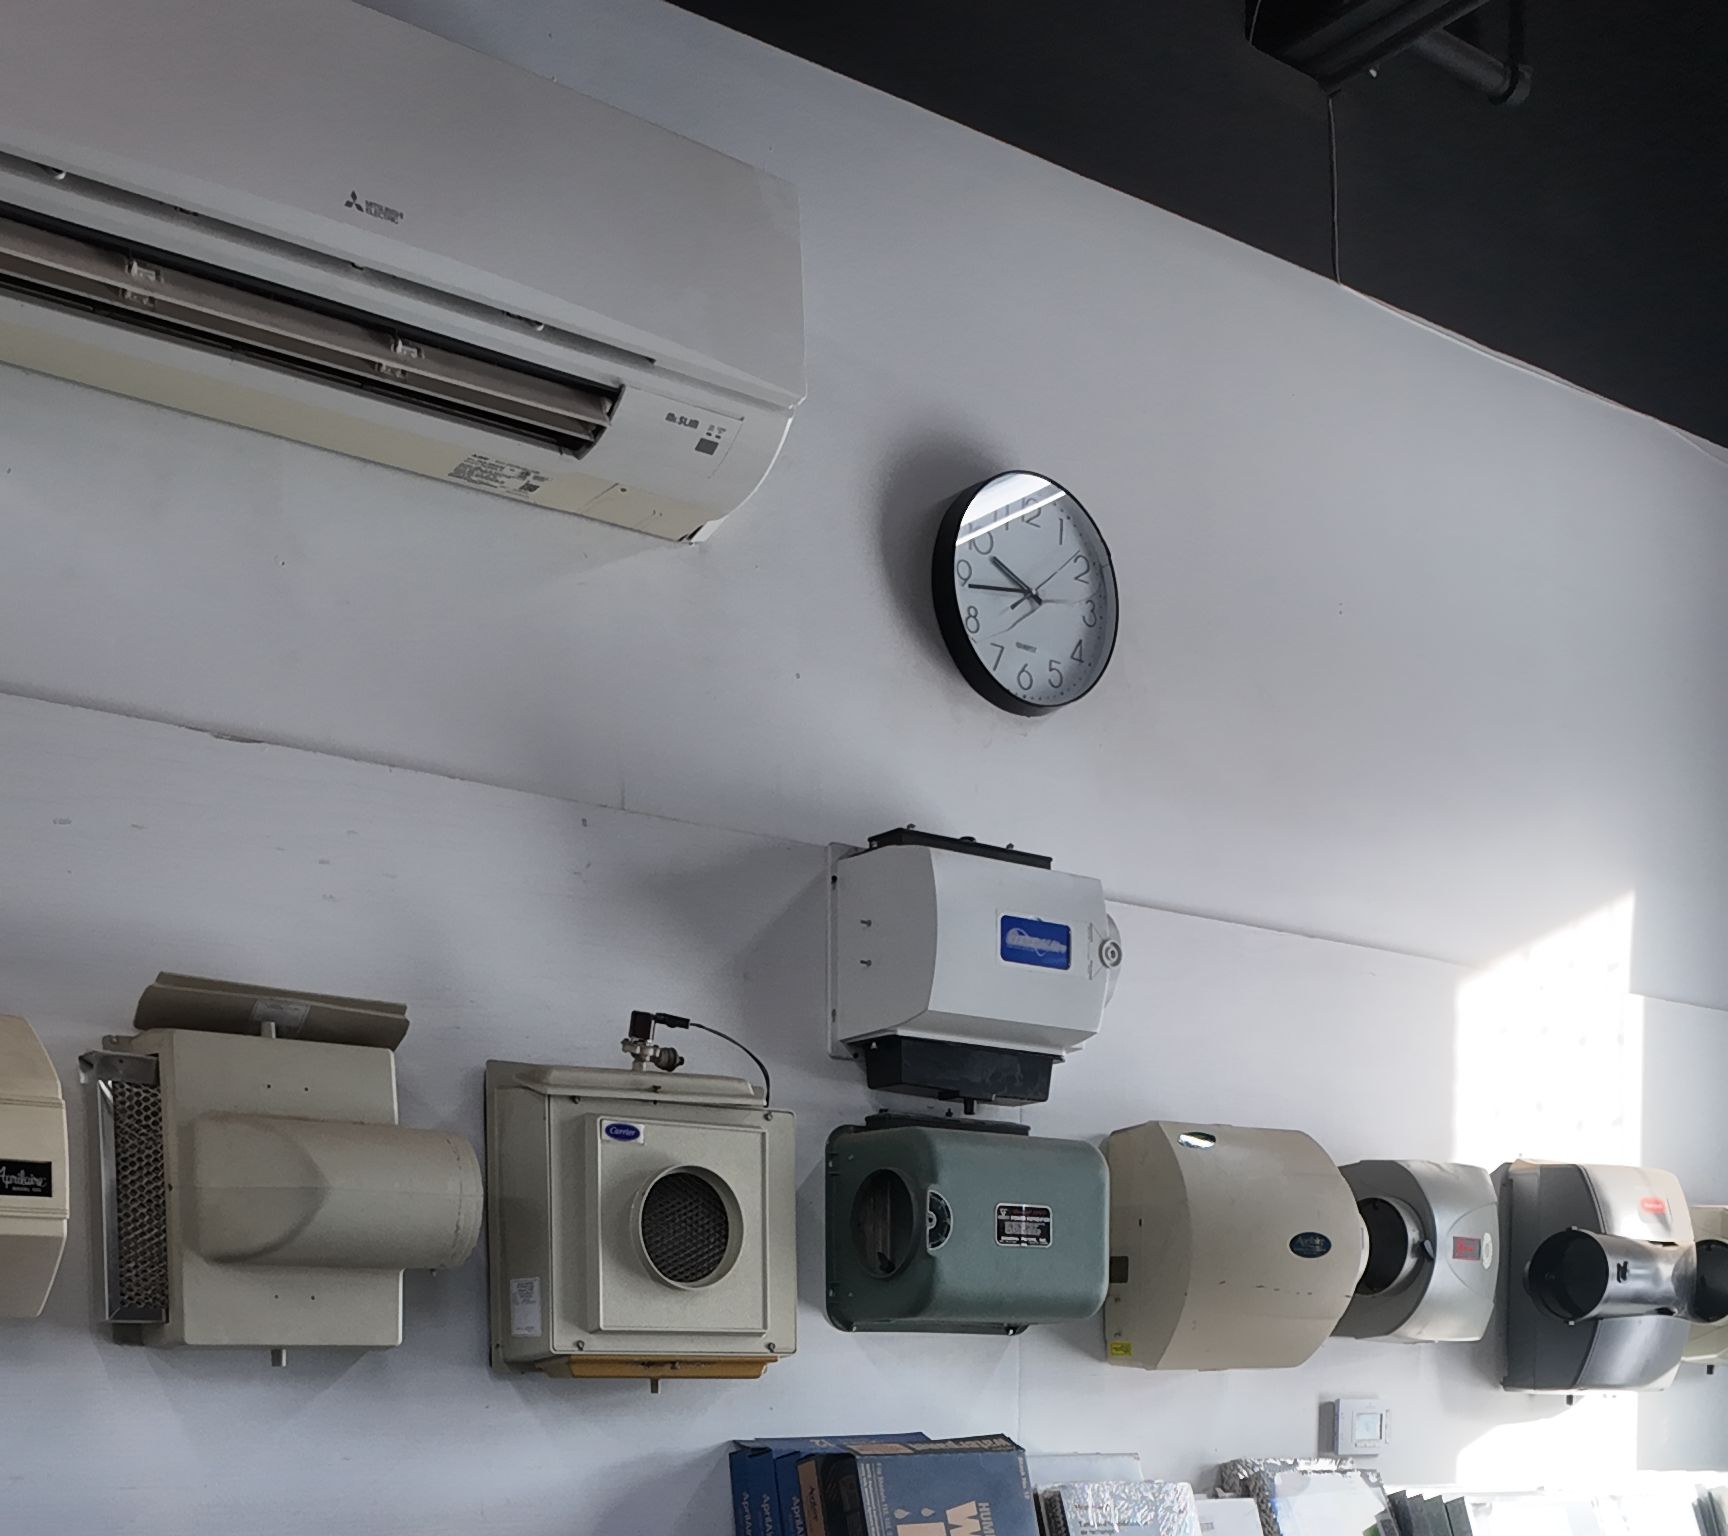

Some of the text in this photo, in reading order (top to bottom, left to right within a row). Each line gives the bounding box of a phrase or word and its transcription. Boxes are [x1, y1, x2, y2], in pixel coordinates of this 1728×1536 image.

[1059, 518, 1064, 546] 1
[956, 559, 973, 587] 9
[1073, 554, 1090, 584] 2
[965, 605, 980, 634] 8
[1082, 599, 1097, 628] 3
[990, 642, 1005, 672] 7
[1070, 639, 1085, 664] 4
[1017, 663, 1033, 691] 6
[1048, 659, 1064, 689] 5
